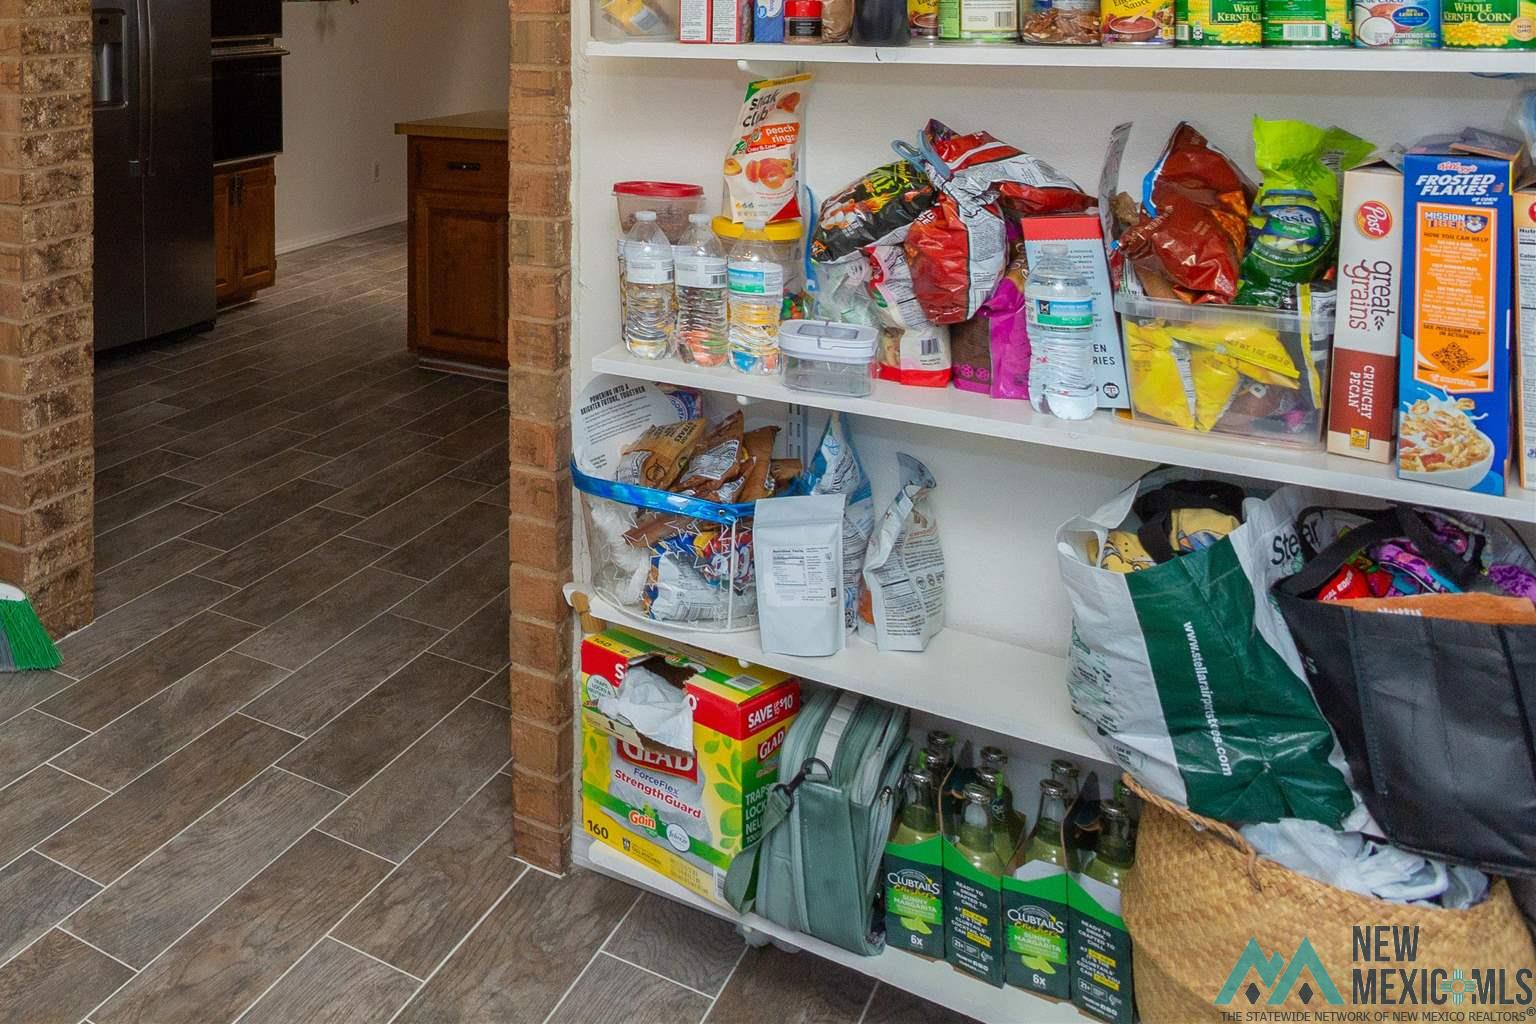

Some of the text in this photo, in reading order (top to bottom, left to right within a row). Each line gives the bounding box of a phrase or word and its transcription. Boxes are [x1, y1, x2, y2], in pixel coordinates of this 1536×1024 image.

[1217, 12, 1251, 22] KERNEL
[1454, 3, 1493, 13] WHOLE
[1478, 12, 1512, 22] CORN
[749, 89, 779, 110] snak
[742, 107, 769, 128] club
[765, 125, 796, 136] peach
[1437, 161, 1478, 174] Kellogg's
[1415, 174, 1497, 186] FROSTED
[1420, 185, 1488, 196] FLAKES
[1363, 204, 1387, 236] Post
[1424, 211, 1465, 222] MISSION
[1344, 259, 1371, 331] grains
[1370, 260, 1395, 317] great
[580, 385, 646, 415] BRIGHTER FUTURE, TOGETHER
[589, 385, 625, 403] POWERING INTO
[1348, 371, 1361, 408] PECAN
[1360, 364, 1375, 420] CRUNCHY
[748, 696, 793, 729] SAVE $10
[759, 729, 785, 760] GLAD
[633, 767, 680, 796] ForceFlex
[615, 768, 702, 820] StrengthGuard
[586, 819, 609, 840] 160
[629, 811, 656, 829] Gain
[887, 872, 941, 895] CLUBTAILS
[955, 880, 975, 893] READY
[894, 896, 937, 913] MARGARITA
[952, 890, 978, 906] CRAFTED
[1007, 908, 1065, 934] CLUBTAILS
[1014, 934, 1062, 953] MARGARITA
